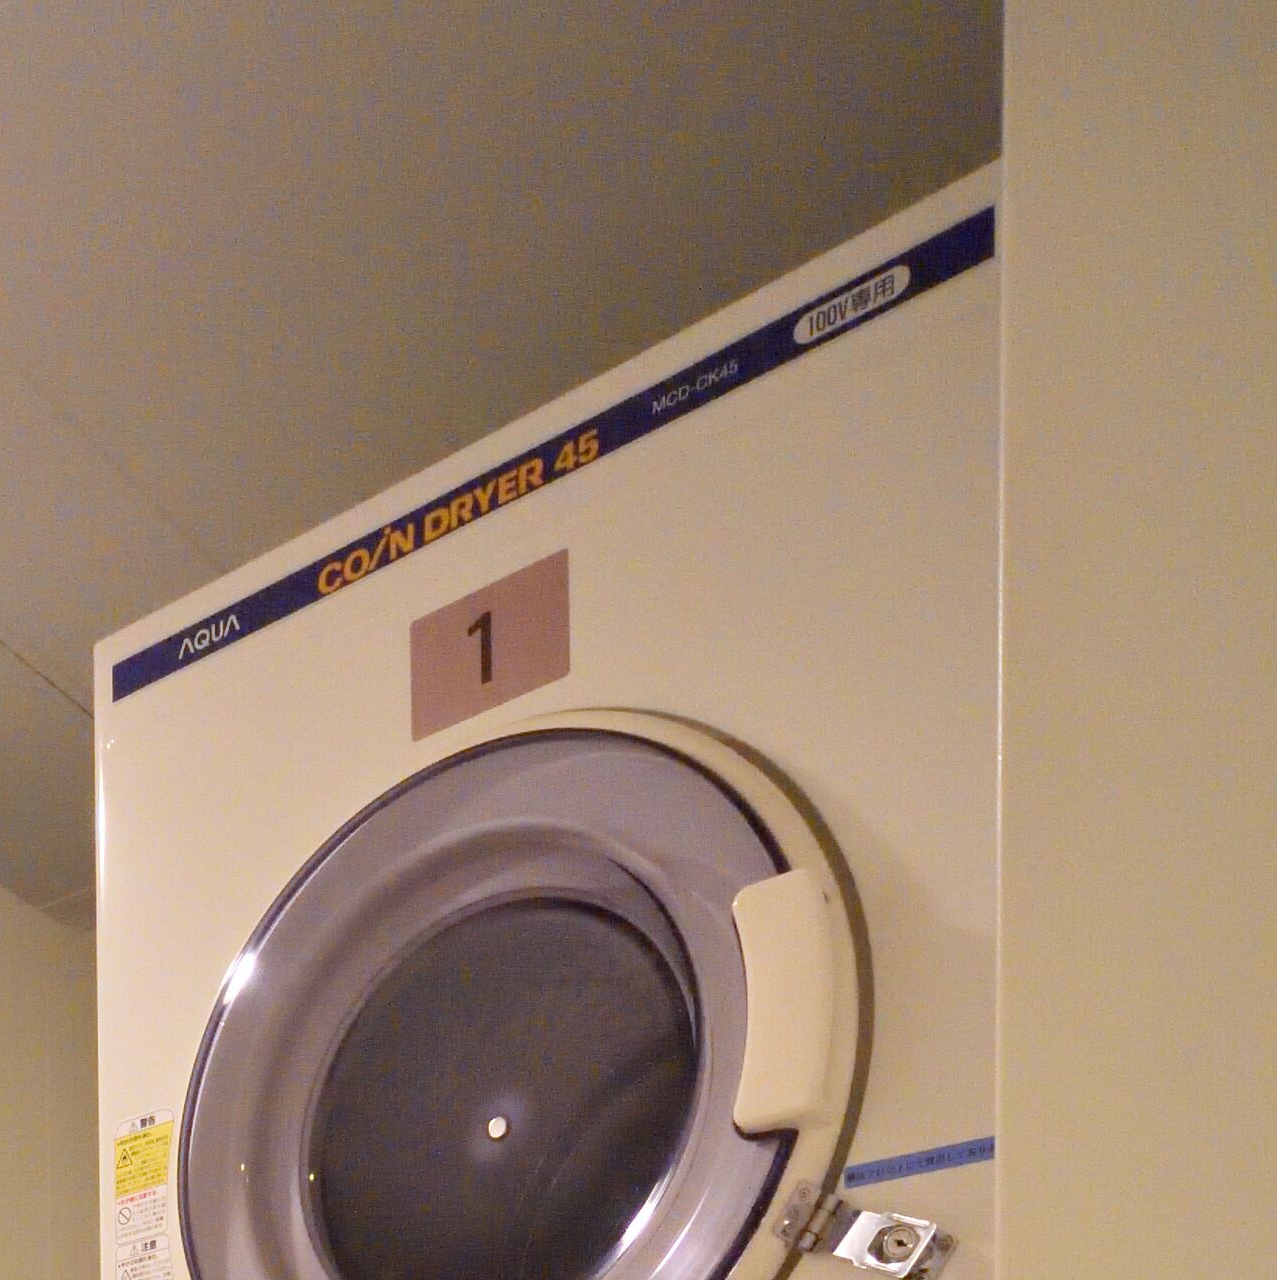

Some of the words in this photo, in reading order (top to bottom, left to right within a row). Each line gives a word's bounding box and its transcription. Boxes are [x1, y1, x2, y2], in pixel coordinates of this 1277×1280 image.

[805, 275, 897, 338] 100V専用
[651, 358, 740, 416] MCD-CK45
[423, 460, 543, 541] DRYER
[555, 429, 601, 475] 45
[178, 614, 241, 660] AQUA
[466, 610, 495, 686] 1
